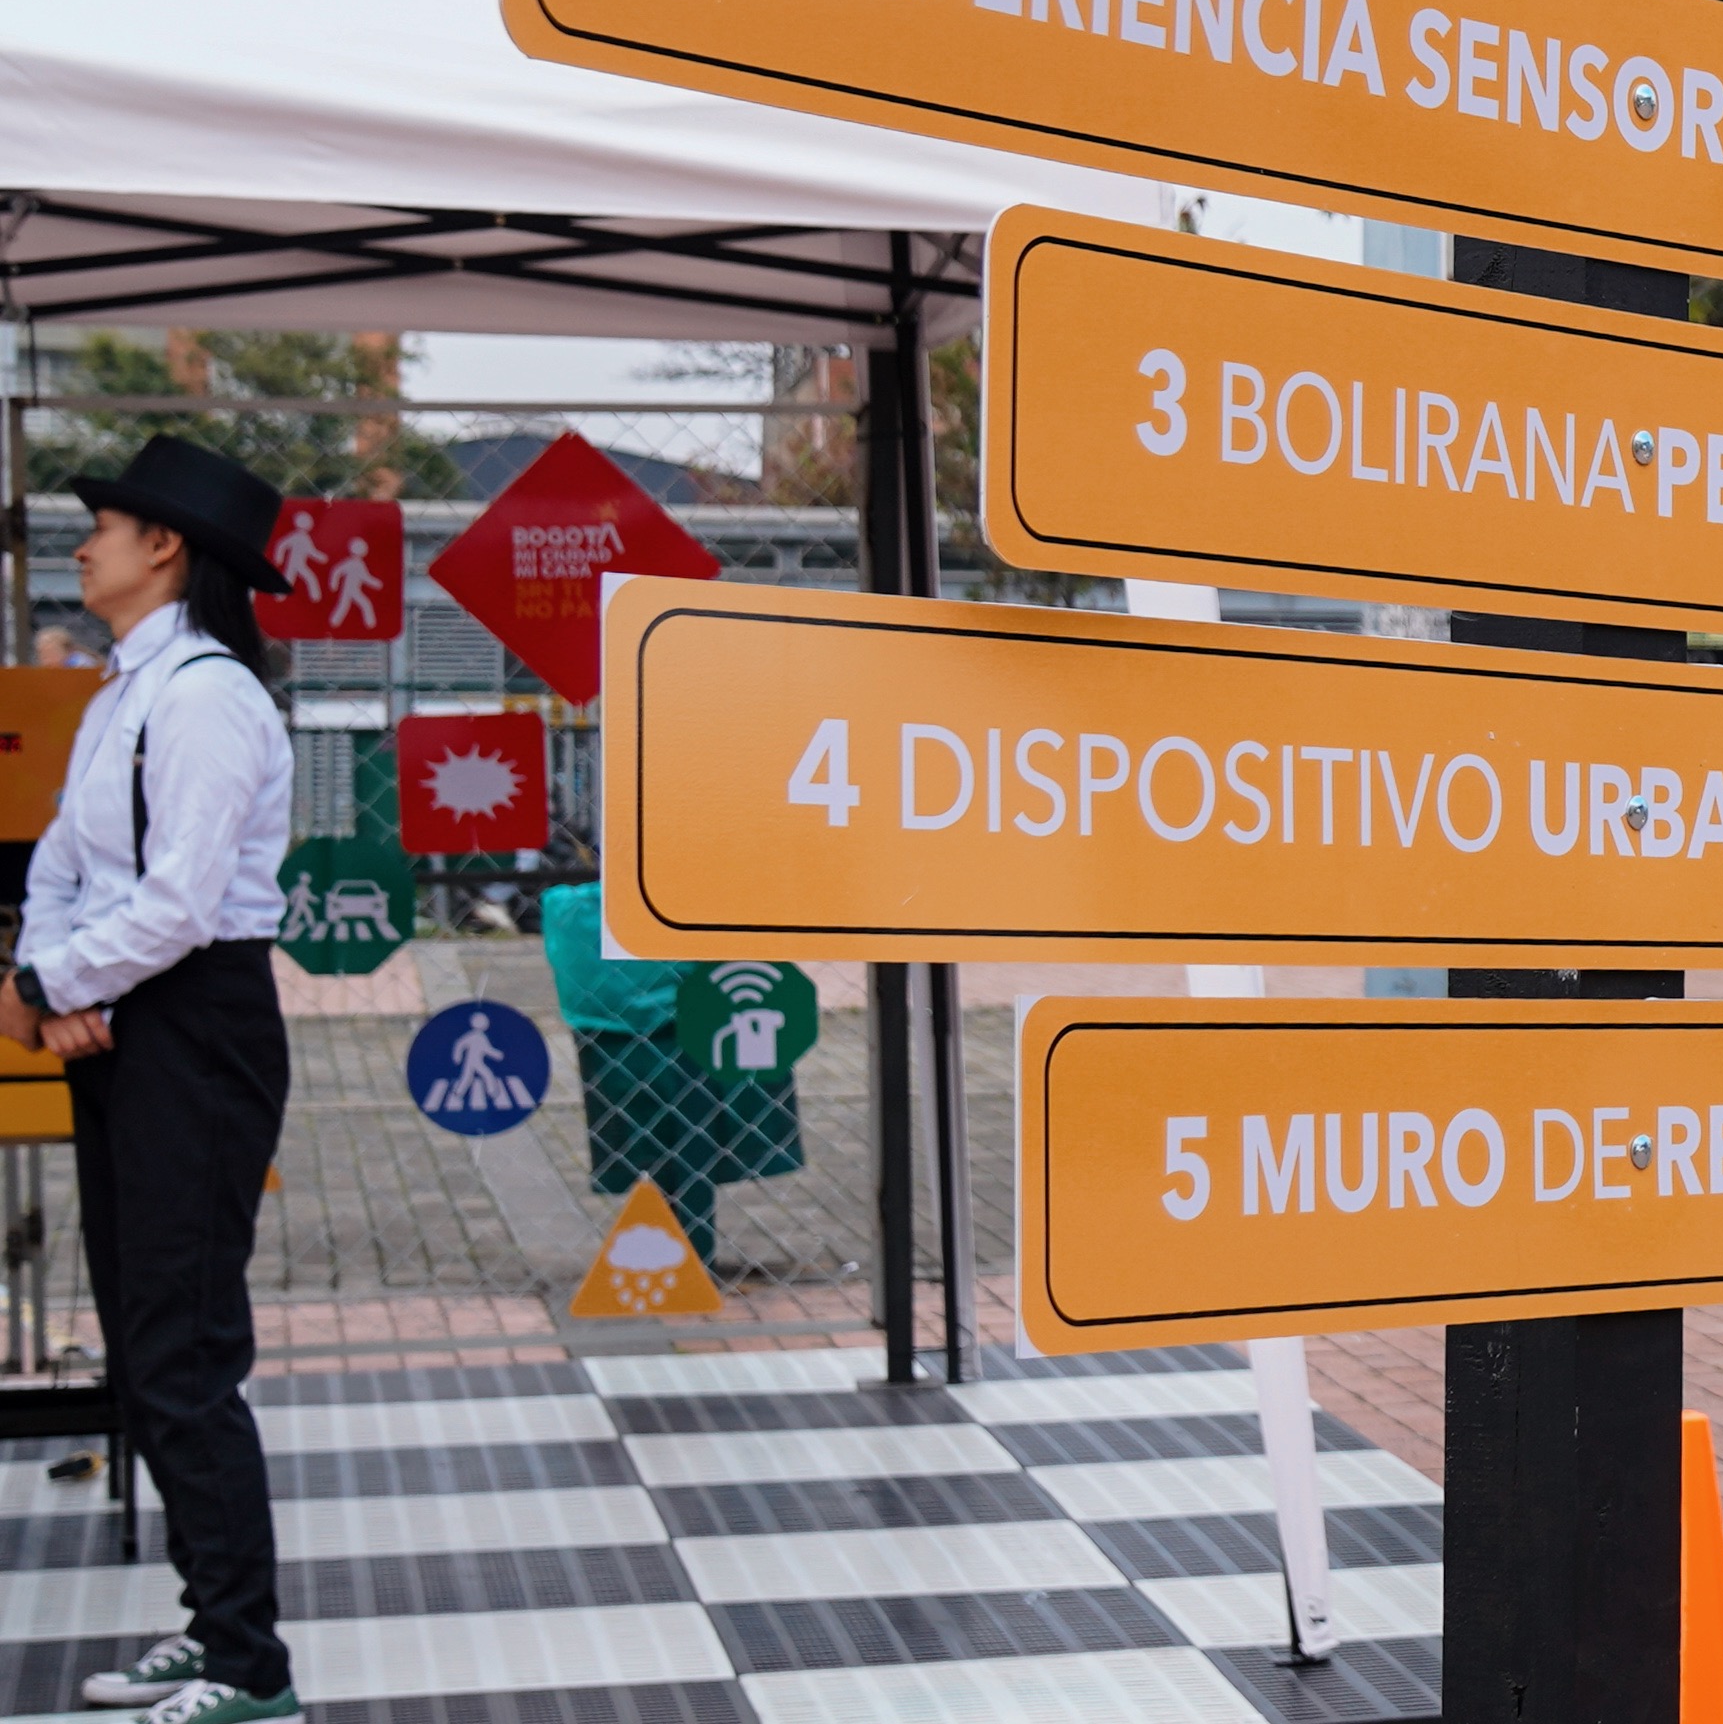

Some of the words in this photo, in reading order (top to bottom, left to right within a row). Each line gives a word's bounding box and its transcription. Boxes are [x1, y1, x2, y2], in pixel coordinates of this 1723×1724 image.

[1134, 347, 1189, 457] 3
[1220, 360, 1636, 514] BOLIRANA
[541, 562, 592, 579] CASA
[786, 717, 862, 828] 4
[899, 721, 1503, 854] DISPOSITIVO
[1160, 1115, 1212, 1222] 5
[1241, 1107, 1507, 1217] MURO
[1532, 1106, 1633, 1203] DE
